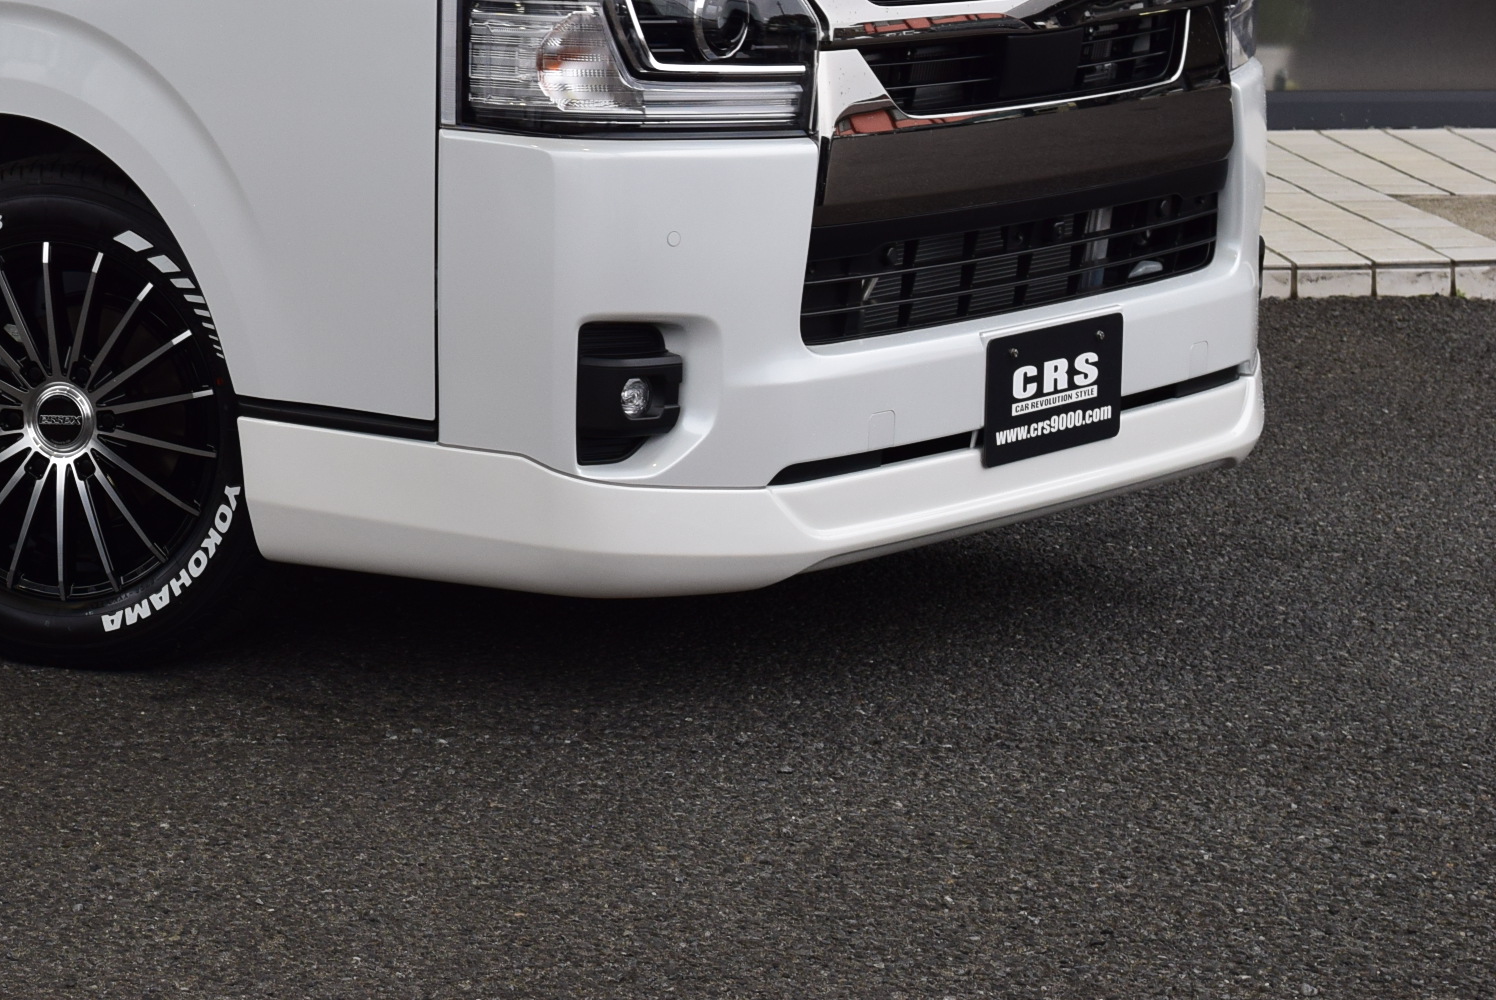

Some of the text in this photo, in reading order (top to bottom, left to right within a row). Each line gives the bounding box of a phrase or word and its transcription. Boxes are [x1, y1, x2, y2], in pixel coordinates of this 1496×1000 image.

[1012, 352, 1099, 399] CRS
[1015, 388, 1095, 414] CAR REVOLUTION STYLE
[995, 405, 1112, 446] www.crs9000.com
[102, 484, 241, 632] YOKOHAMA
